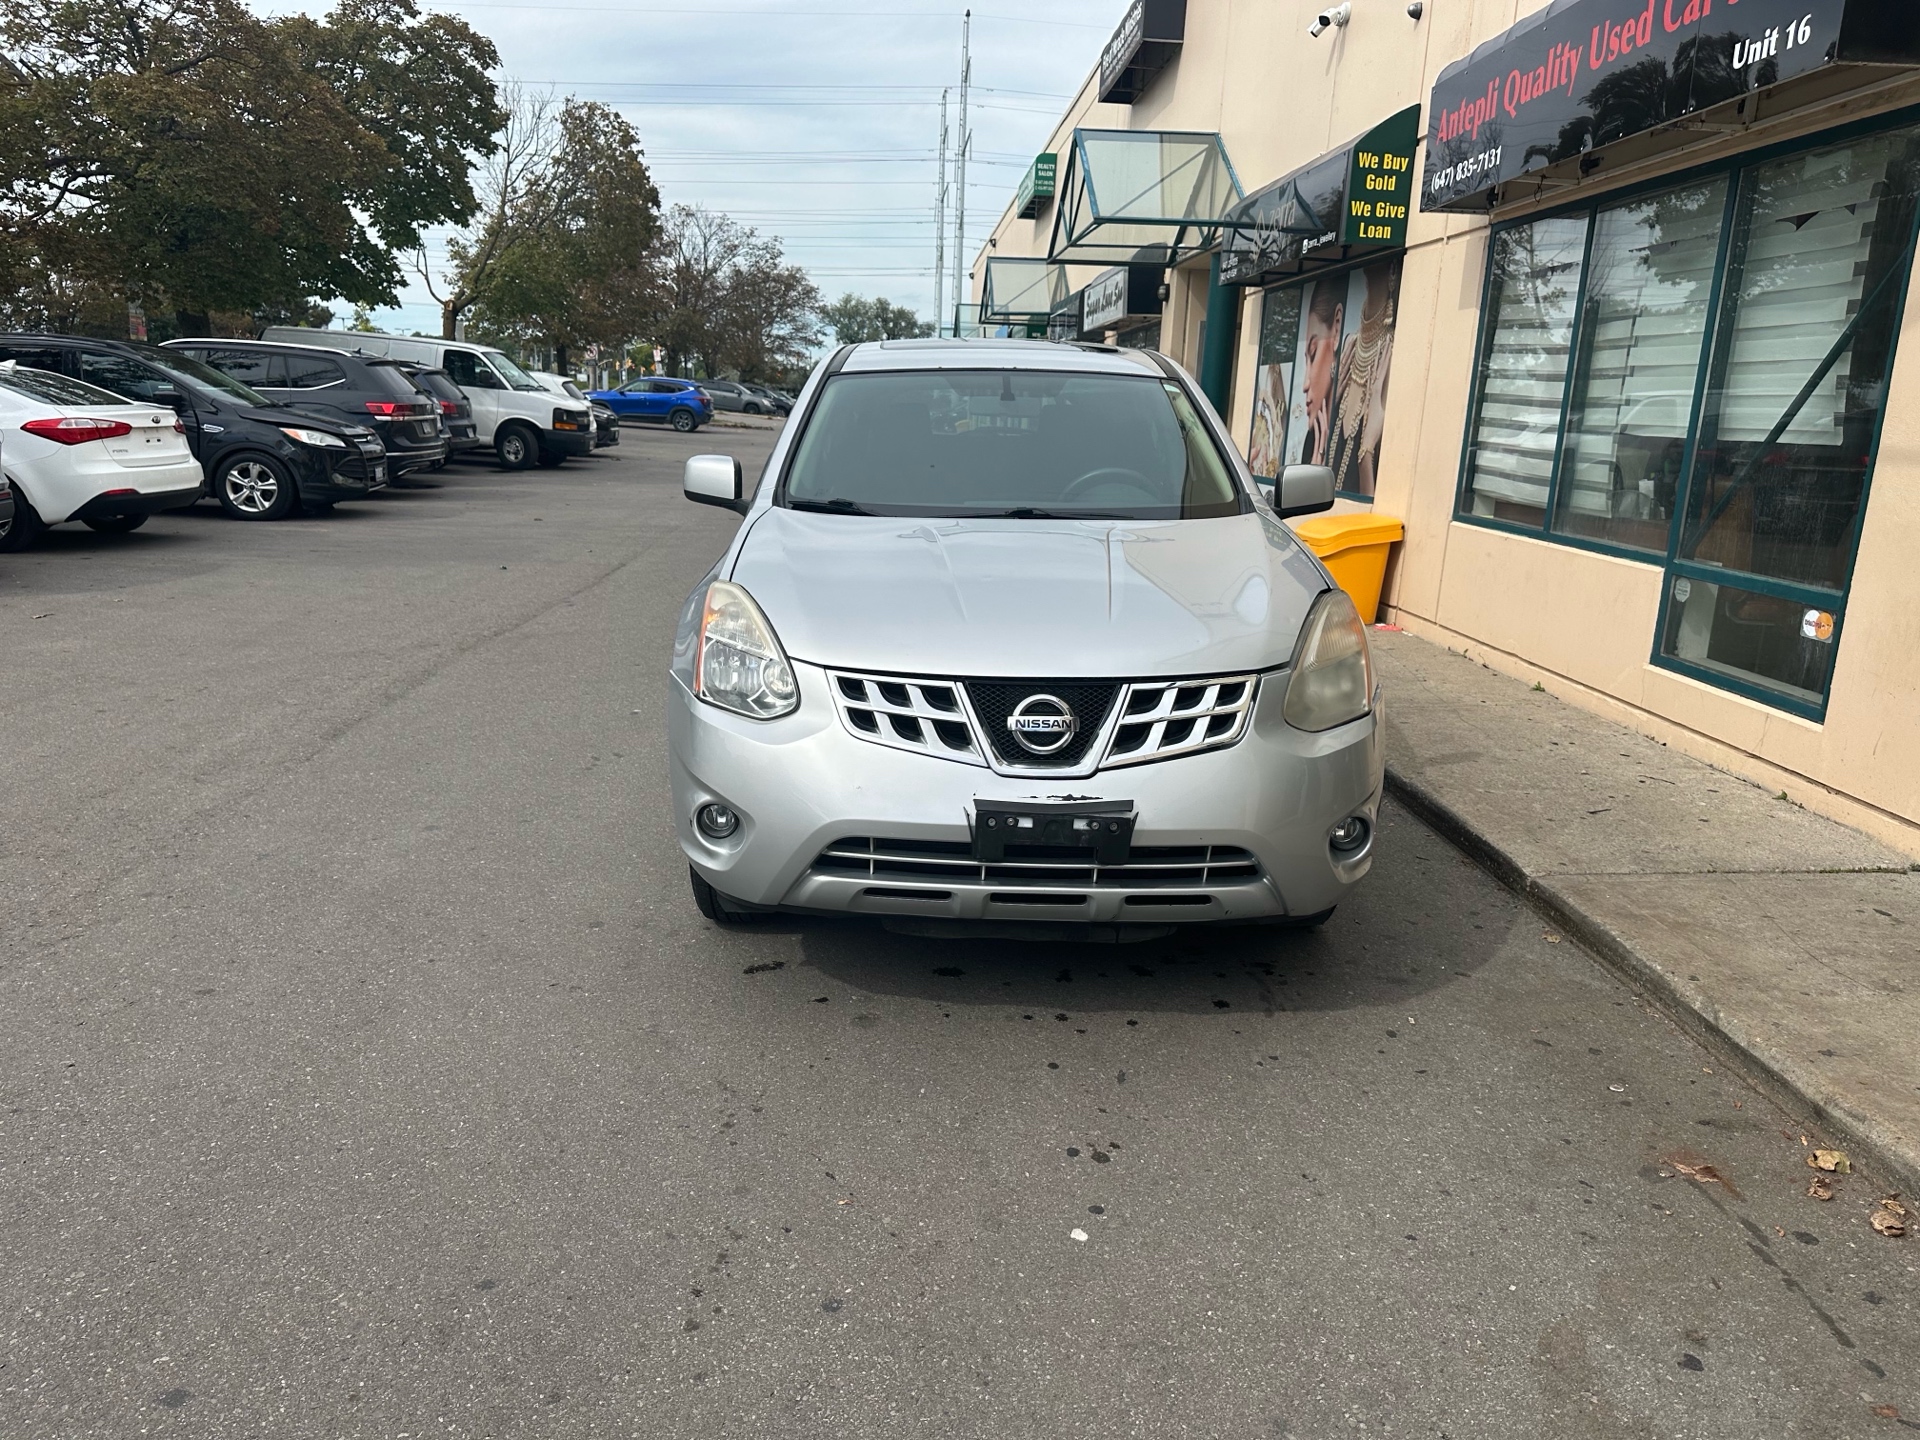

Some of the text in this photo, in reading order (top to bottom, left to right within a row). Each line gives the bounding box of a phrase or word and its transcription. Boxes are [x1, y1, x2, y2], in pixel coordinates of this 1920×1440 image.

[1732, 13, 1812, 69] Unit 16
[1436, 76, 1499, 145] Antepli
[1503, 40, 1583, 119] Quality
[1589, 0, 1656, 70] Used
[1358, 152, 1409, 172] We Buy
[1431, 145, 1502, 194] (647) 835-7131
[1366, 173, 1396, 191] Gold
[1351, 200, 1406, 219] We Give
[1359, 222, 1391, 239] Loan
[1014, 718, 1073, 729] NISSAN
